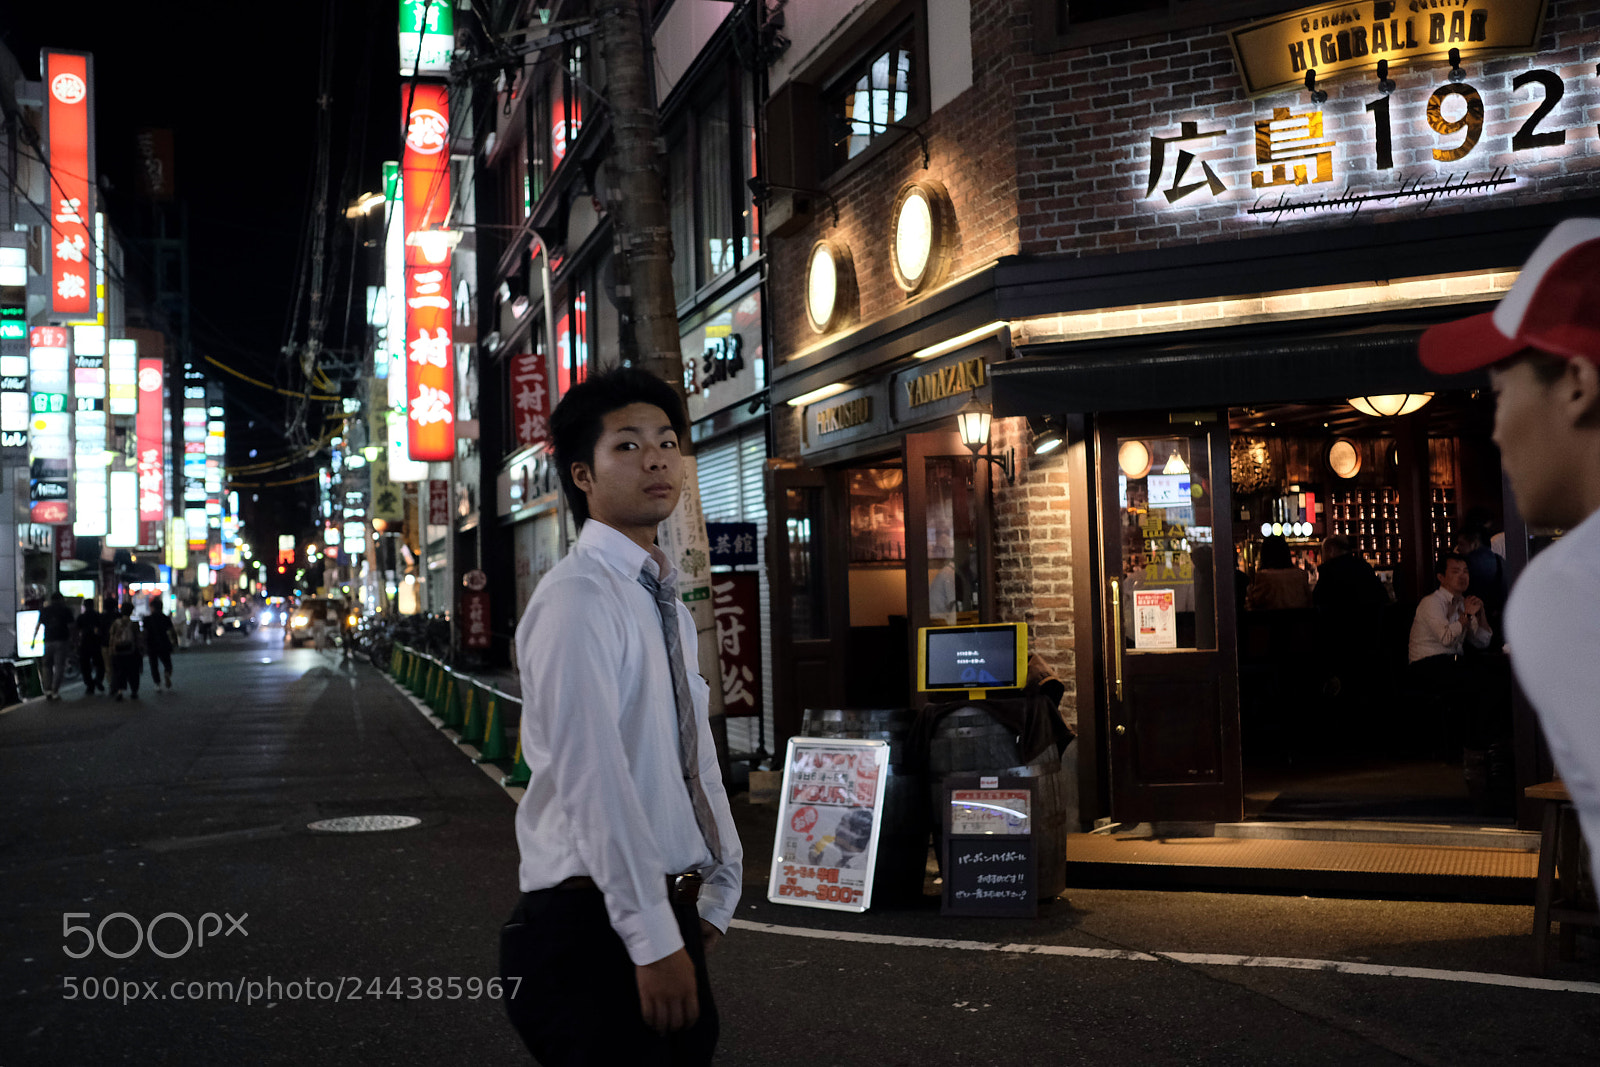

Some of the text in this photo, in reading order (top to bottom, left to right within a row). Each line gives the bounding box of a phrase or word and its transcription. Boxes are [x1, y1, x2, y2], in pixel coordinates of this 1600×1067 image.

[1288, 8, 1489, 73] HIGHBALL BAR
[407, 270, 453, 427] 三村松
[515, 355, 548, 441] 三村松
[904, 356, 985, 407] YAMAZAKI
[709, 533, 754, 553] 芸館
